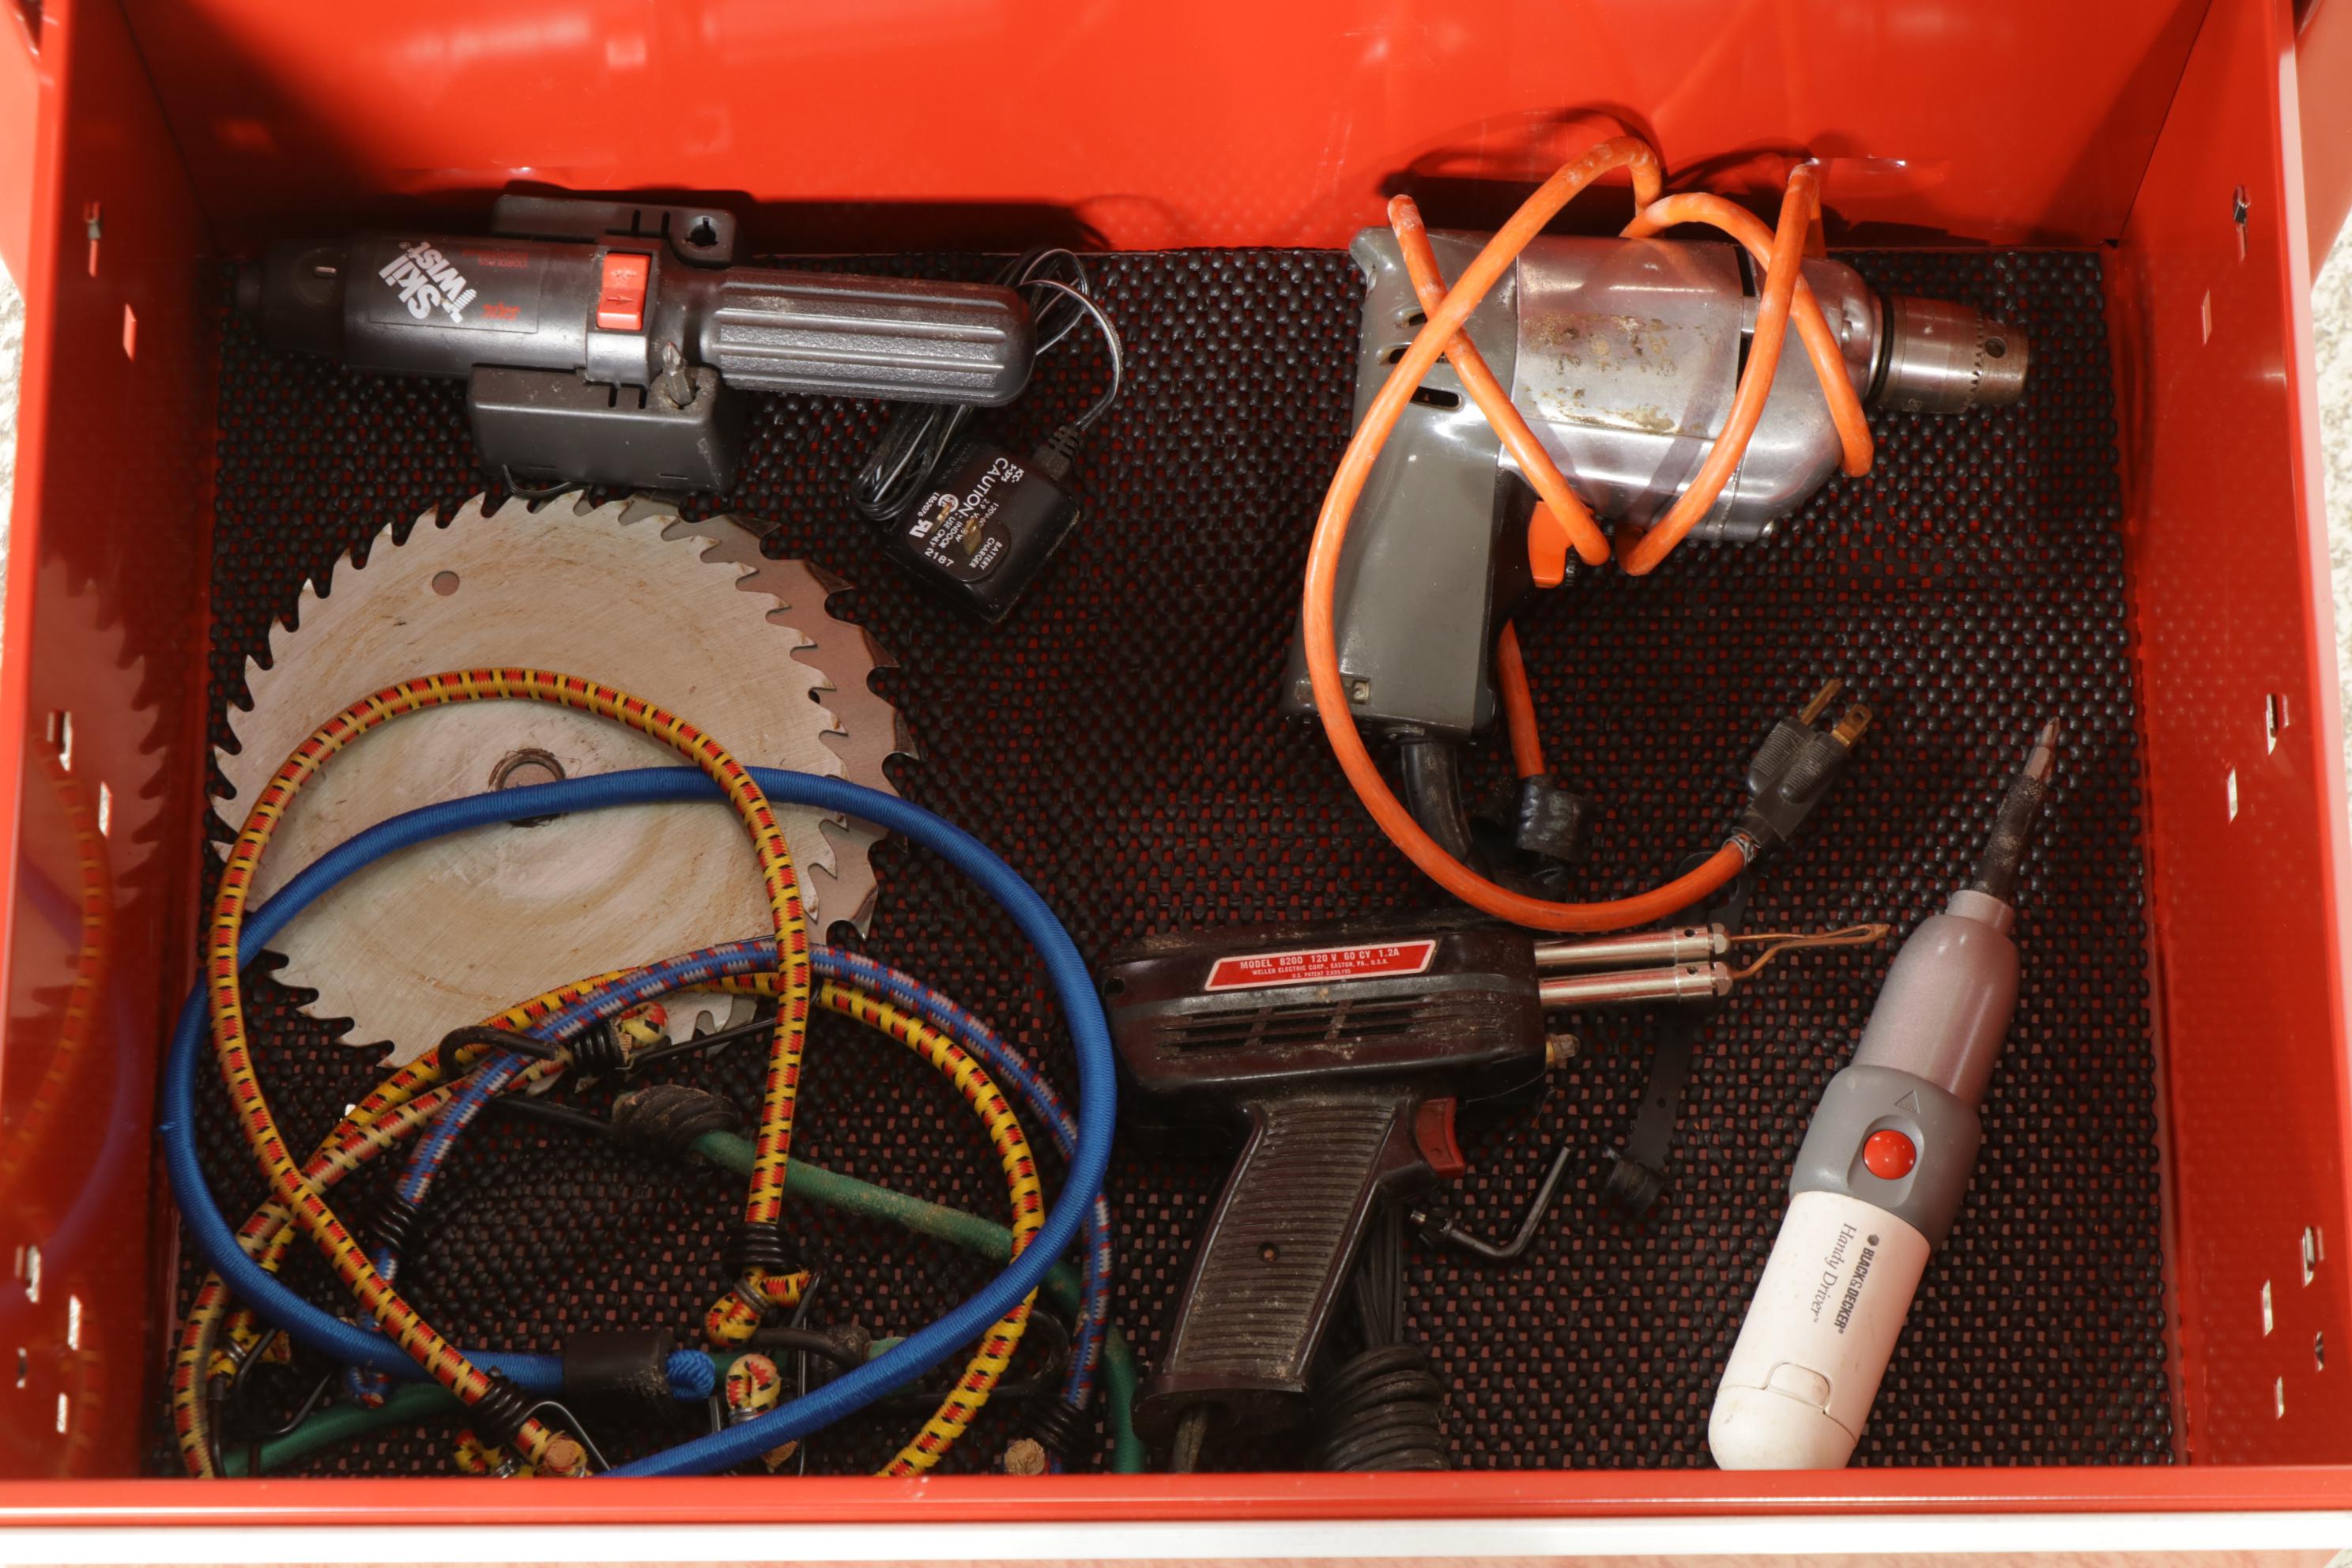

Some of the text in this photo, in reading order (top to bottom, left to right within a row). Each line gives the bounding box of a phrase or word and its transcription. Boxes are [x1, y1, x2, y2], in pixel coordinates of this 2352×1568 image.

[379, 254, 442, 319] Skil
[955, 457, 1009, 519] CAUTION:
[917, 492, 941, 517] LR62076
[929, 516, 956, 548] USE ONLY
[938, 521, 963, 548] INDOOR
[924, 547, 955, 568] 2187
[968, 537, 996, 569] CHARGER
[979, 541, 1004, 571] BATTERY
[1240, 948, 1400, 970] MODEL 8200 120 V 60 CY 1.2A
[1252, 967, 1276, 976] WELLER
[1278, 964, 1306, 974] ELECTRIC
[1824, 1223, 1857, 1271] Handy
[1834, 1246, 1875, 1329] BLACK&DECKER
